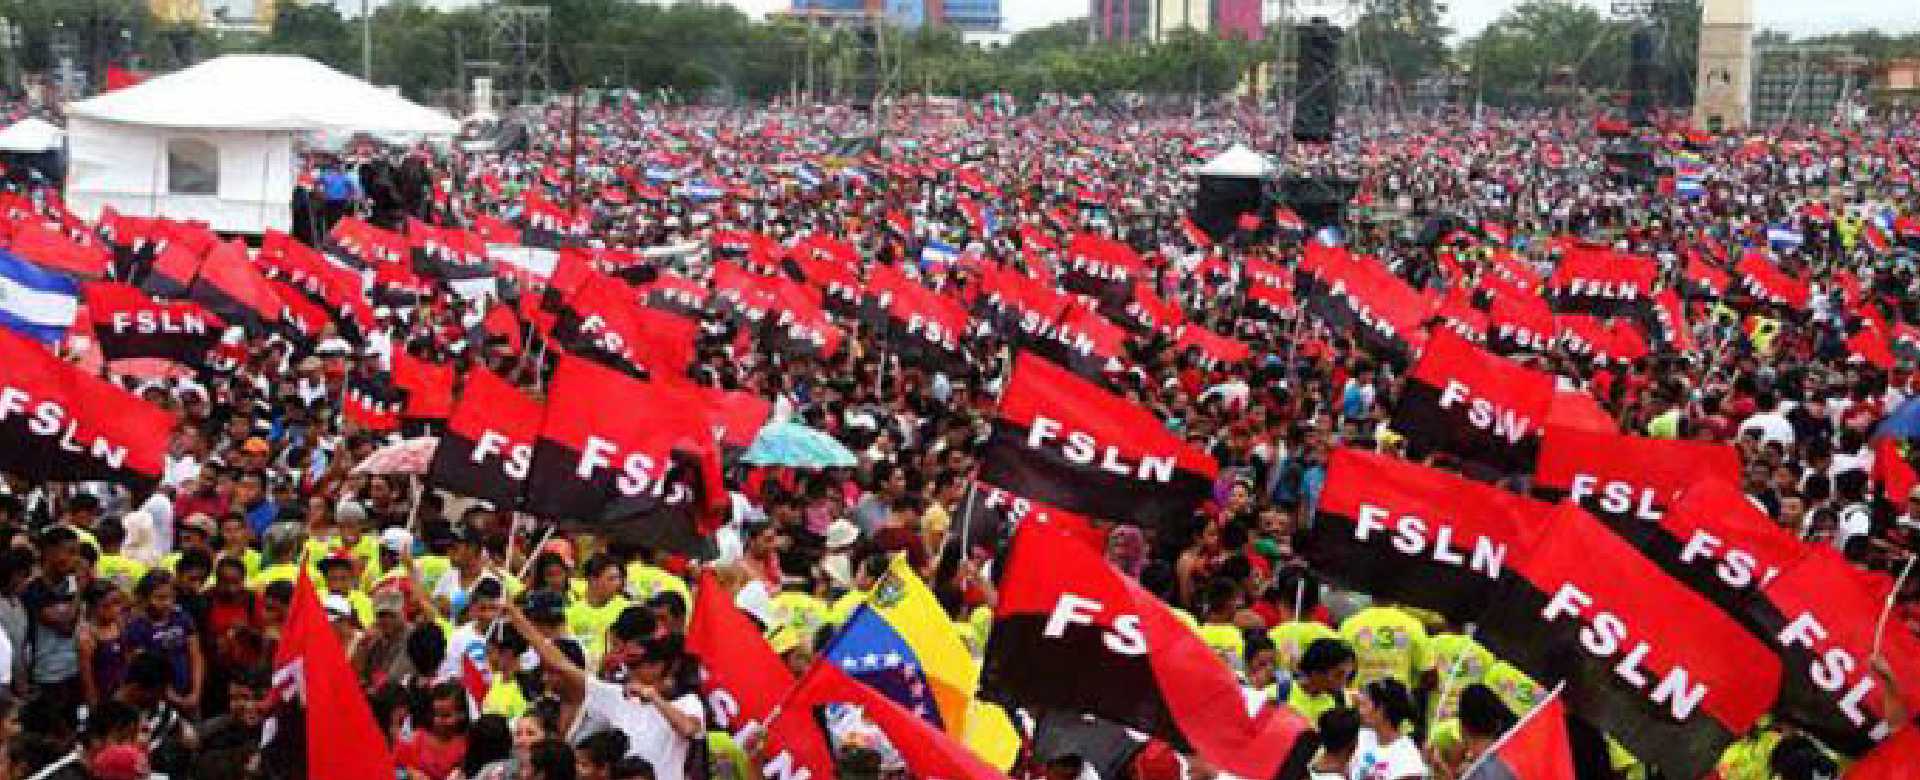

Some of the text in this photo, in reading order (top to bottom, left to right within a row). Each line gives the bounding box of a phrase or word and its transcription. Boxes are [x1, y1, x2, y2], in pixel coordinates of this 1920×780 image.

[1072, 255, 1128, 281] FSLN
[1571, 278, 1635, 300] FSLN
[112, 310, 205, 334] FSLN
[0, 386, 128, 469] FSLN
[1028, 414, 1177, 482] FSLN
[1355, 503, 1508, 580] FSLN
[1541, 582, 1709, 721] FSLN
